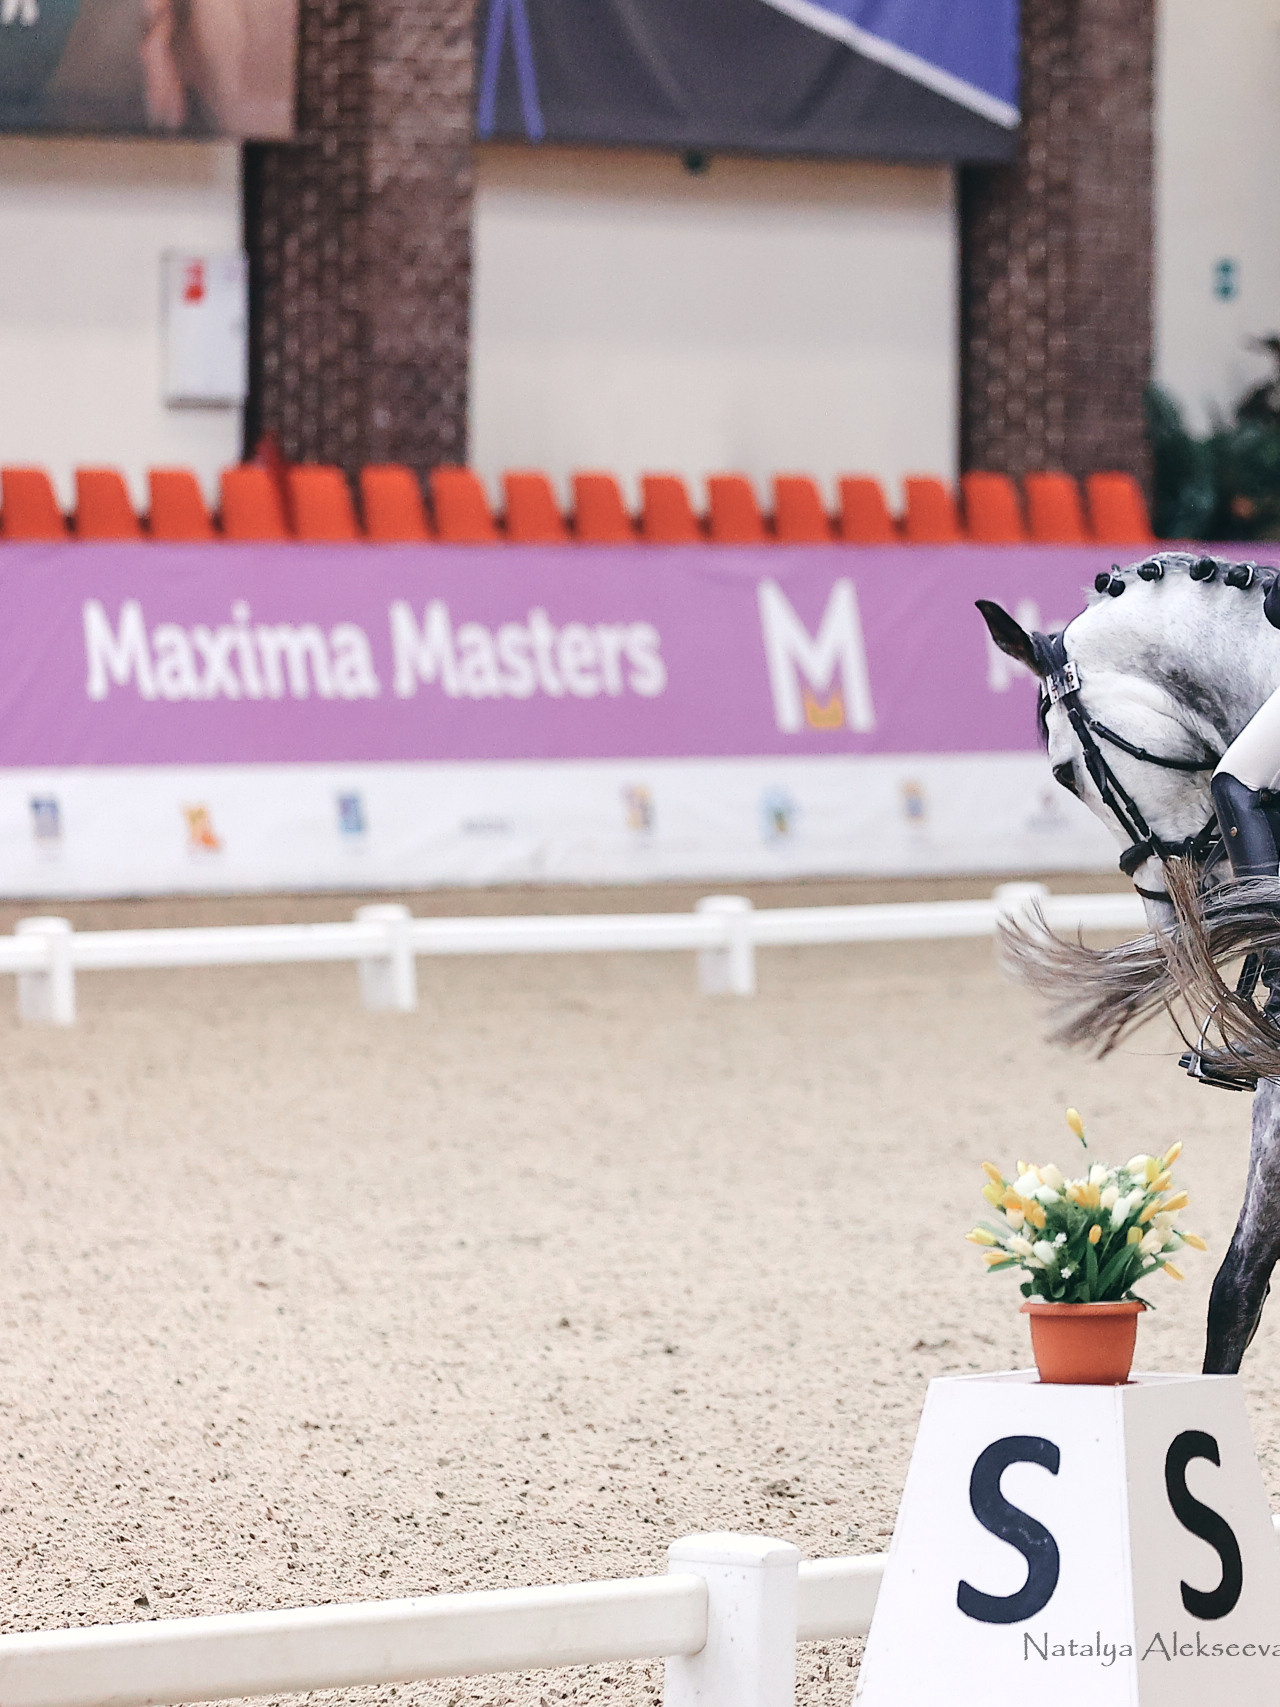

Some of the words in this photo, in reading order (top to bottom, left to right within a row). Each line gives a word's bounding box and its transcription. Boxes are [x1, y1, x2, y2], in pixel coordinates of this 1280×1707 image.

[83, 598, 381, 701] Maxima
[390, 598, 668, 699] Masters
[757, 577, 876, 734] M
[957, 1435, 1060, 1624] S
[1165, 1430, 1243, 1620] S
